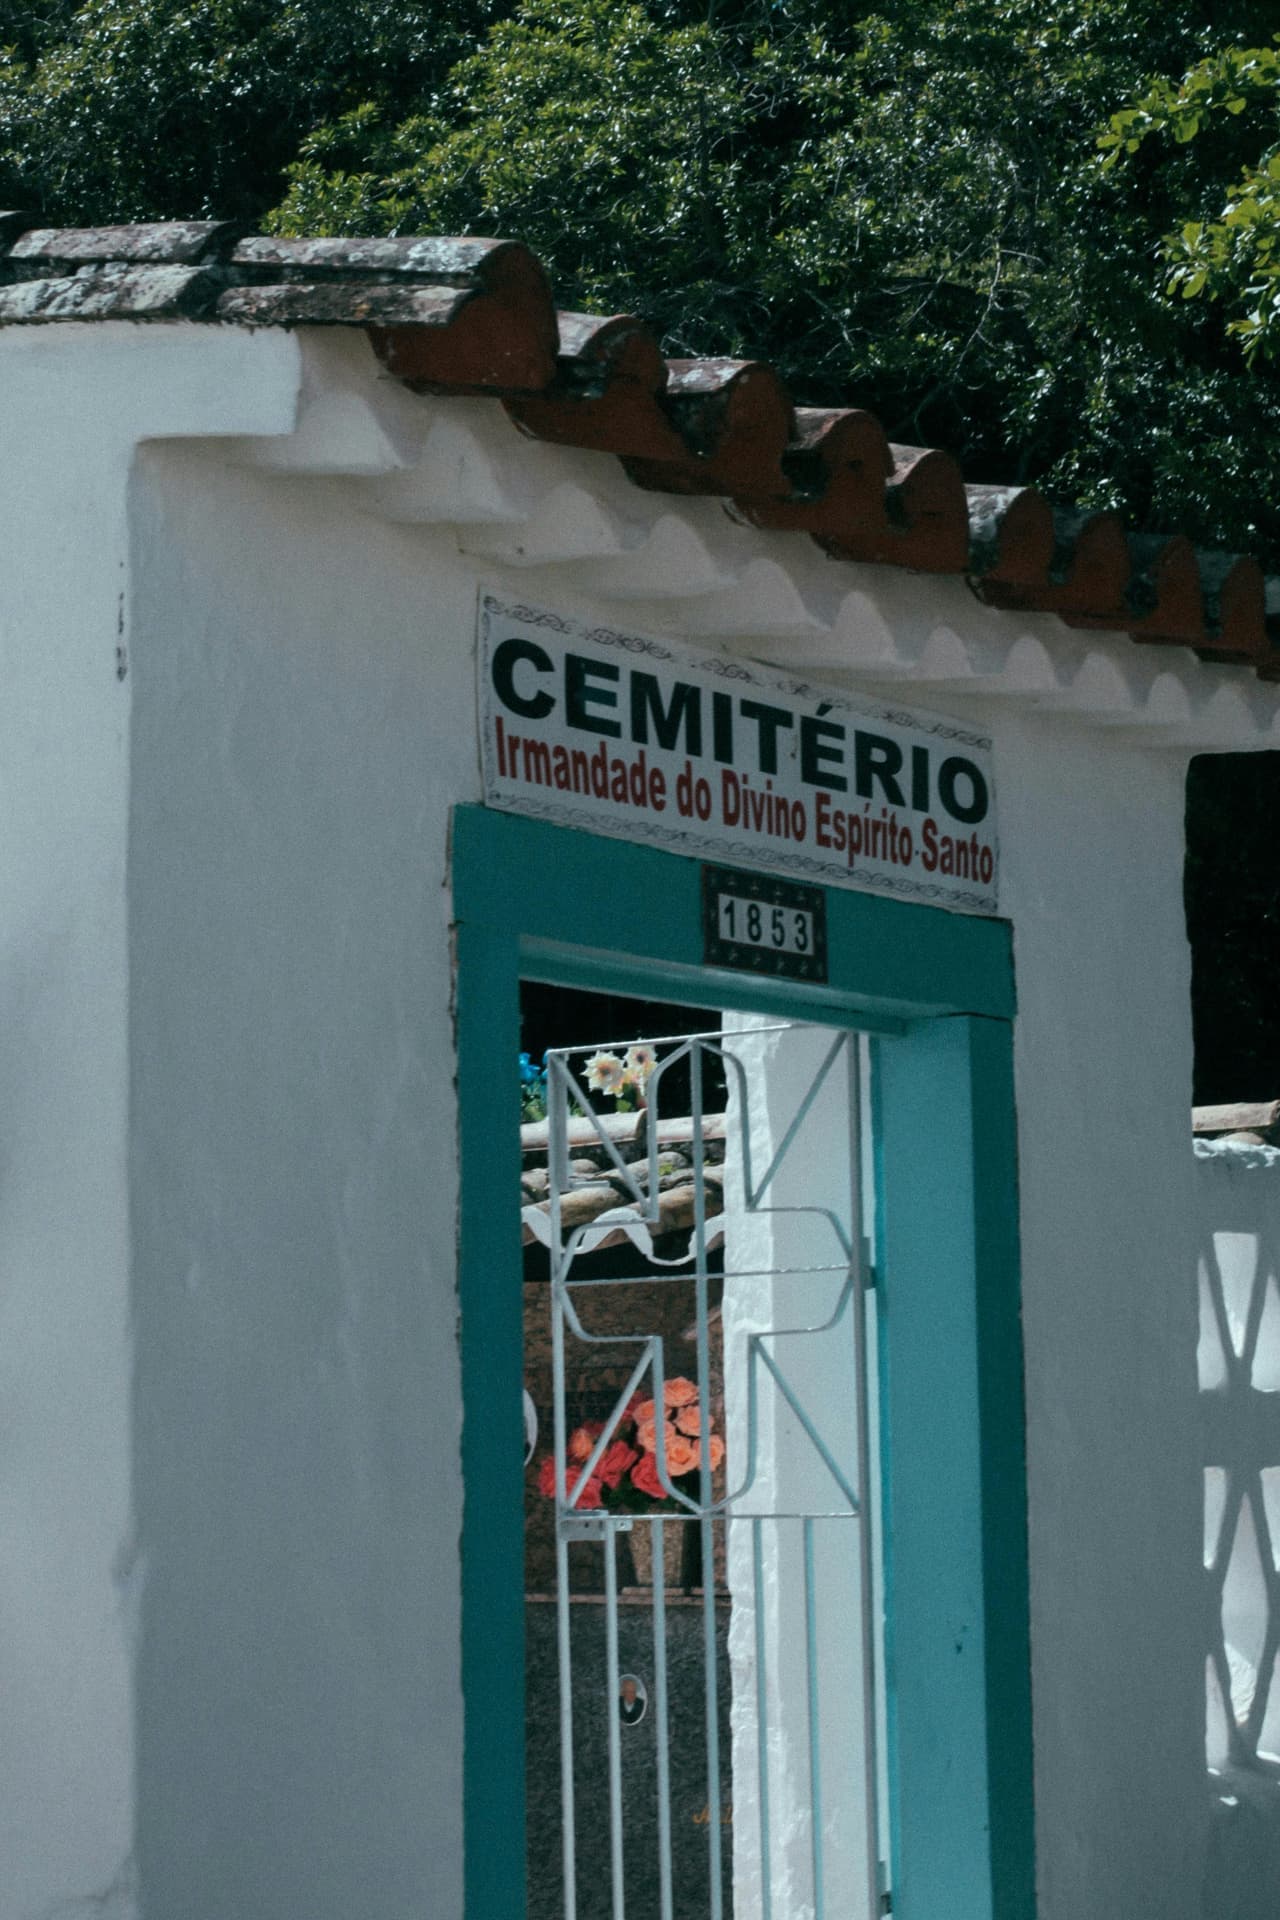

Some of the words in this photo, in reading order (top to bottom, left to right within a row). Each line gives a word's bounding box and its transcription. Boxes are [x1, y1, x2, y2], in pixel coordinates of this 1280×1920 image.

[491, 637, 989, 825] CEMITÉRIO
[495, 715, 667, 812] Irmandade
[675, 760, 712, 822] do
[721, 768, 807, 843] Divino
[815, 791, 913, 868] Espírito
[921, 817, 994, 885] Santo
[724, 899, 809, 952] 1853
